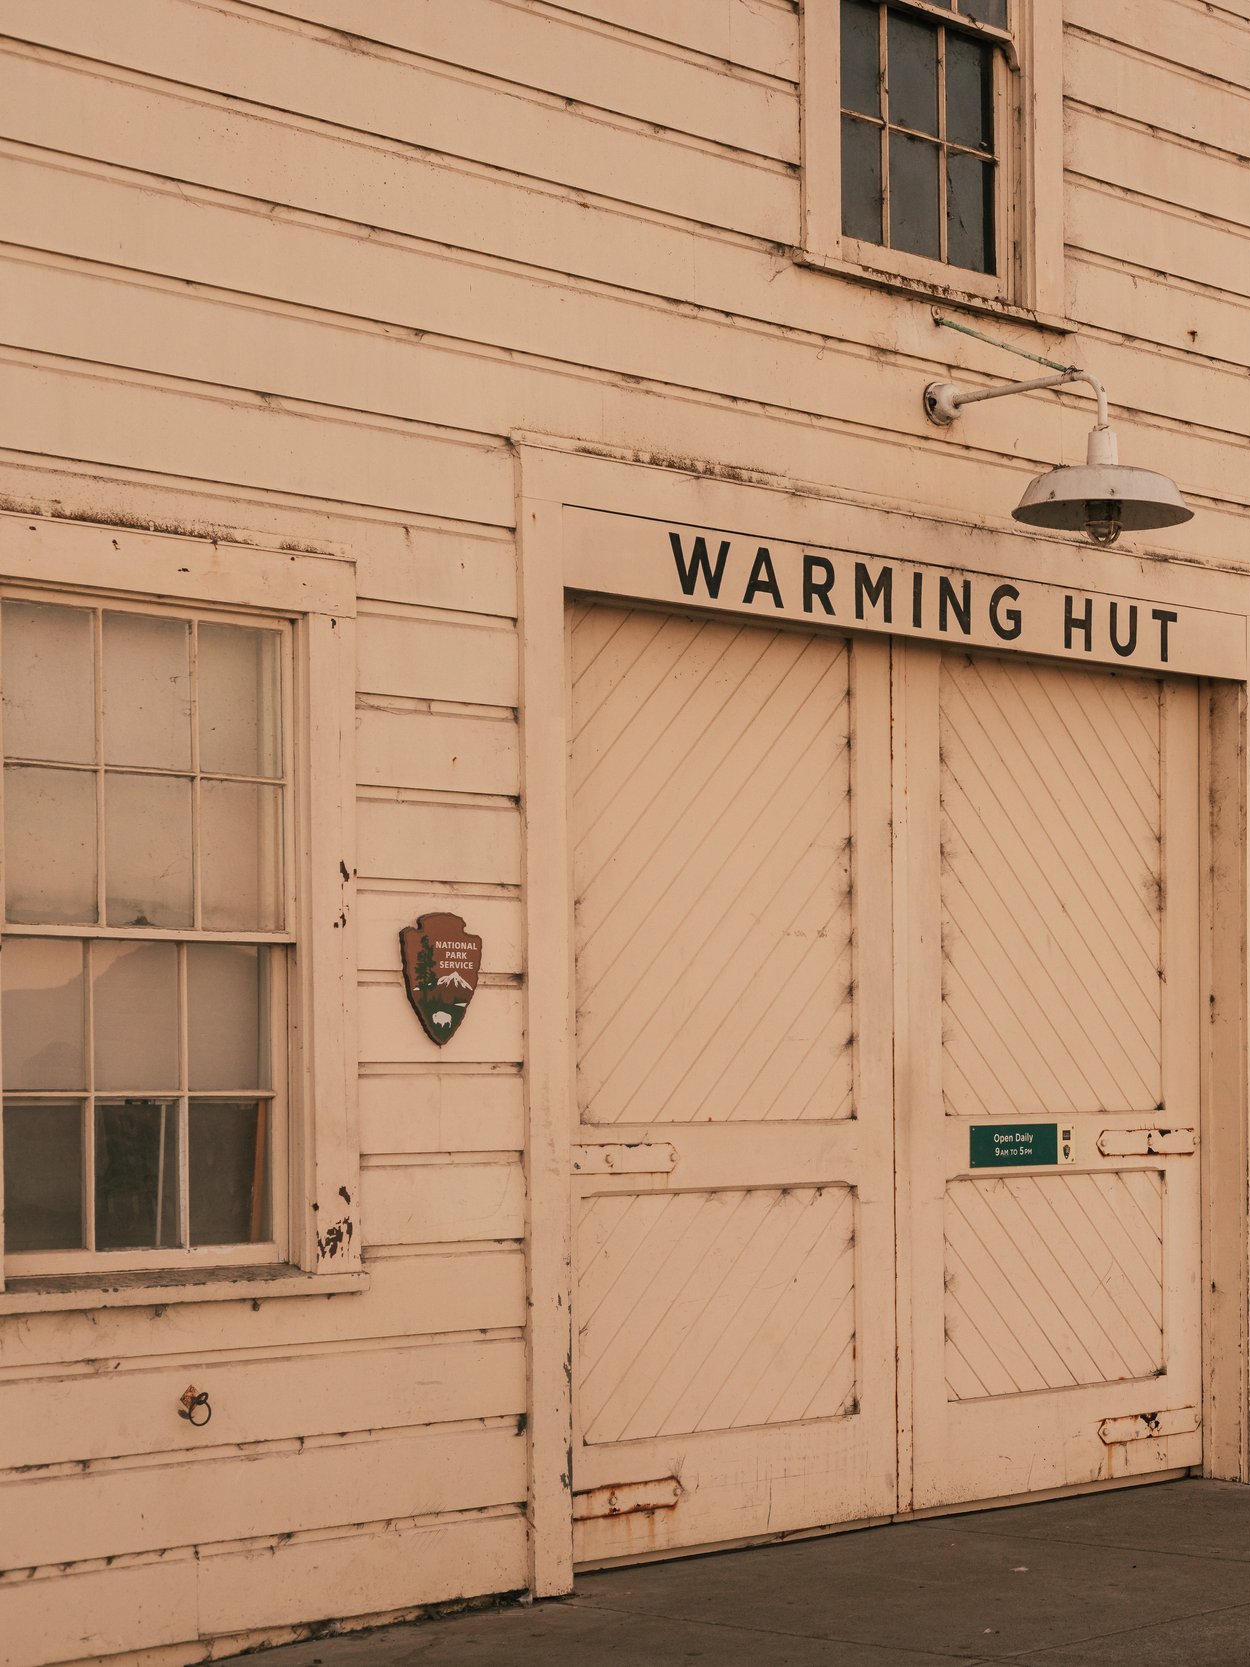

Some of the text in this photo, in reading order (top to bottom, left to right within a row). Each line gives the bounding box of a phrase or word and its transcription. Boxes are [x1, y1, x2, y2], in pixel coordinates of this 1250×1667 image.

[668, 531, 1178, 662] WARMING HUT
[435, 941, 477, 950] NATIONAL
[445, 951, 467, 959] PARK
[439, 960, 473, 969] SERVICE
[993, 1132, 1034, 1144] Open Daily
[1010, 1148, 1018, 1156] TO
